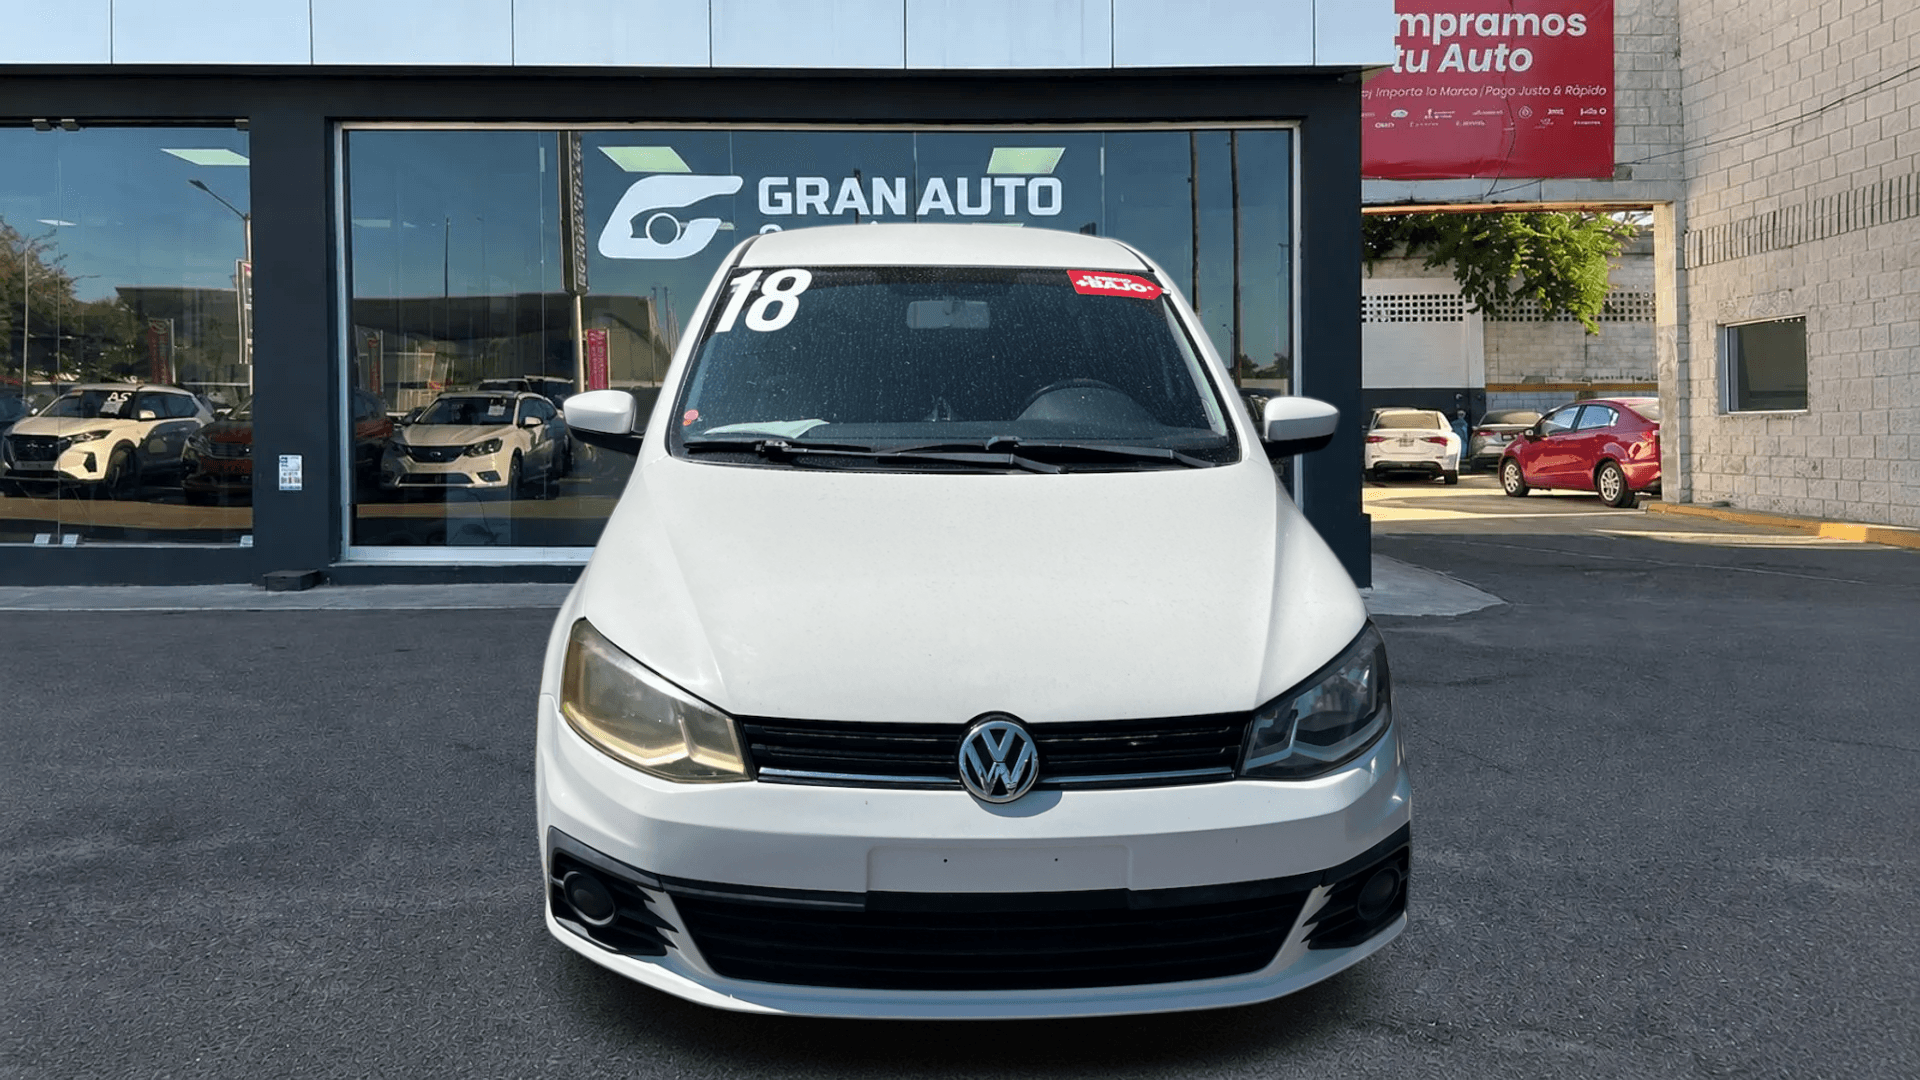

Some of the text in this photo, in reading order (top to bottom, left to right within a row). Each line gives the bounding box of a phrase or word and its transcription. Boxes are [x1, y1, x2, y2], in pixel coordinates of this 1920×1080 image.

[1395, 12, 1587, 45] mpramos
[1392, 44, 1533, 73] tu Auto
[1375, 87, 1423, 100] Importa
[1440, 86, 1478, 97] Marca
[1519, 85, 1550, 96] Justo
[758, 176, 1063, 216] GRAN AUTO
[713, 268, 813, 334] 18
